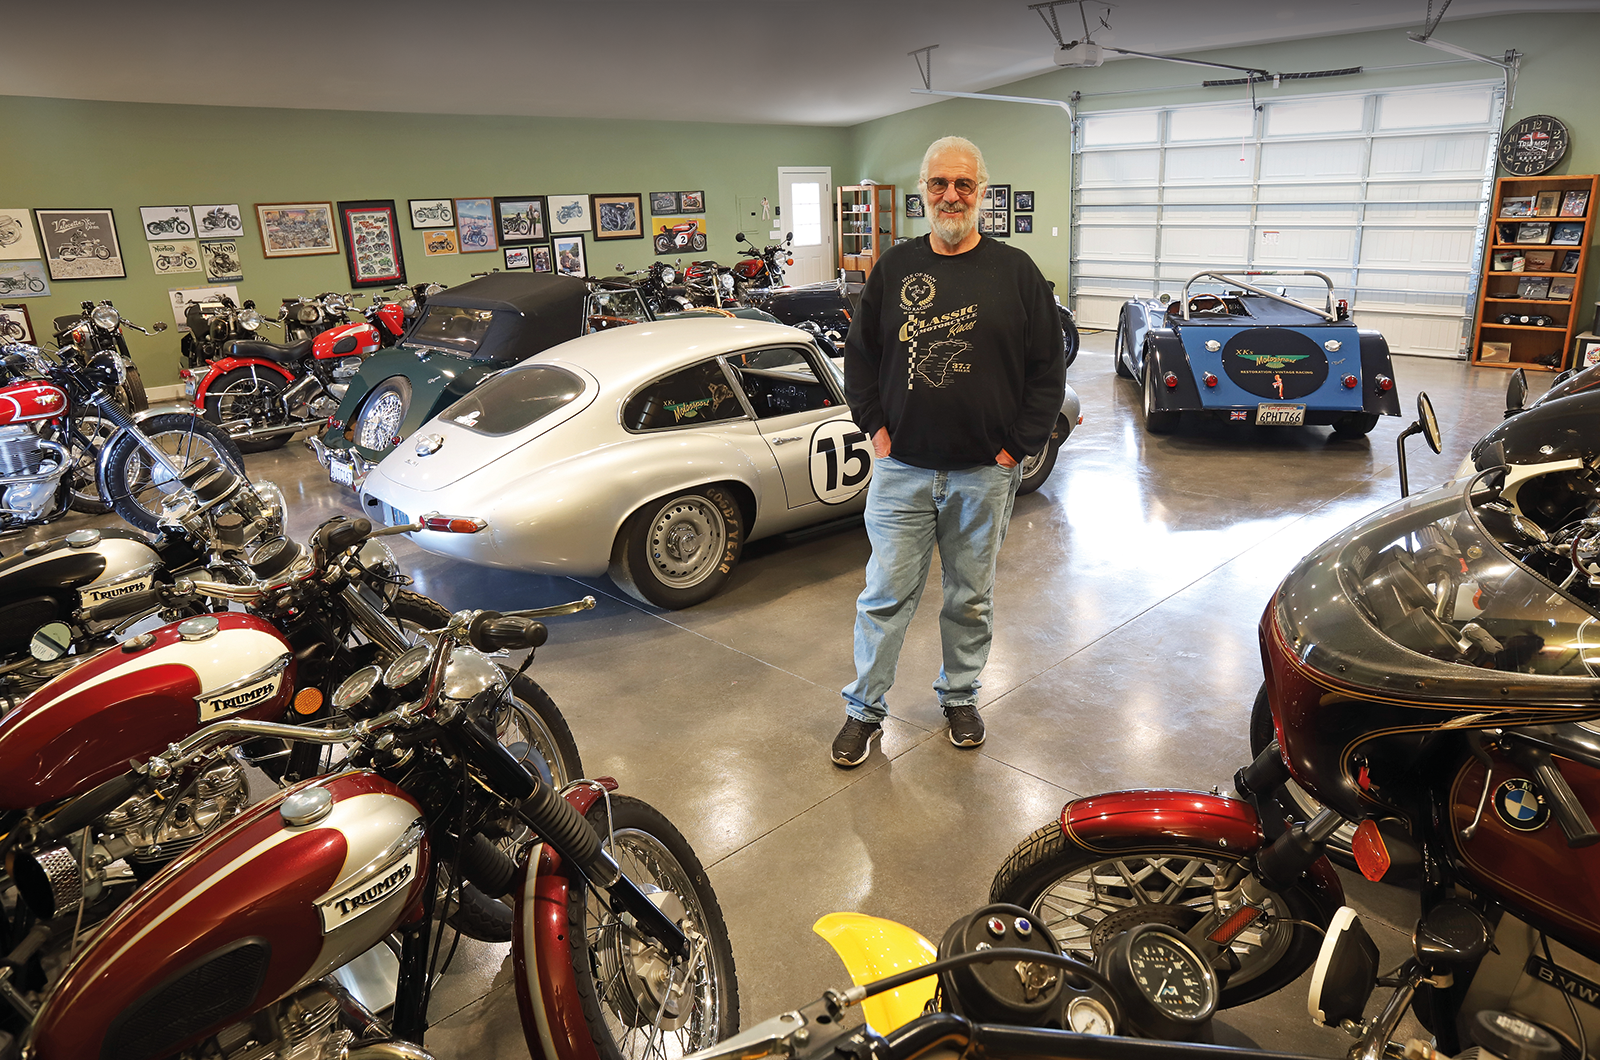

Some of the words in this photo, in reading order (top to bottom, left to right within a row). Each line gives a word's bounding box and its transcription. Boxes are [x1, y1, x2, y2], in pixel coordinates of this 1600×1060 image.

[1521, 124, 1528, 133] 11
[1532, 120, 1542, 130] 12
[1547, 122, 1551, 131] 1
[1509, 134, 1518, 143] 10
[1553, 130, 1560, 139] 2
[1503, 145, 1511, 153] 9
[1554, 140, 1562, 150] 3
[1505, 155, 1514, 164] 8
[1548, 151, 1555, 160] 4
[1514, 162, 1521, 171] 7
[1524, 164, 1533, 173] 6
[1536, 161, 1545, 170] 5
[680, 236, 687, 244] 2
[201, 243, 236, 254] Norton
[901, 274, 913, 283] ISLE
[924, 273, 937, 283] MAN
[899, 302, 912, 311] ROAD
[912, 302, 934, 311] RACING
[898, 304, 978, 342] CLASSIC
[919, 312, 978, 334] MOTORCYCLE
[1260, 411, 1301, 423] 6PHT766
[816, 431, 871, 491] 15
[90, 582, 146, 601] TRIUMPH
[210, 683, 275, 712] TRIUMPH
[335, 863, 412, 916] TRIUMPH
[1539, 966, 1599, 1002] BMW
